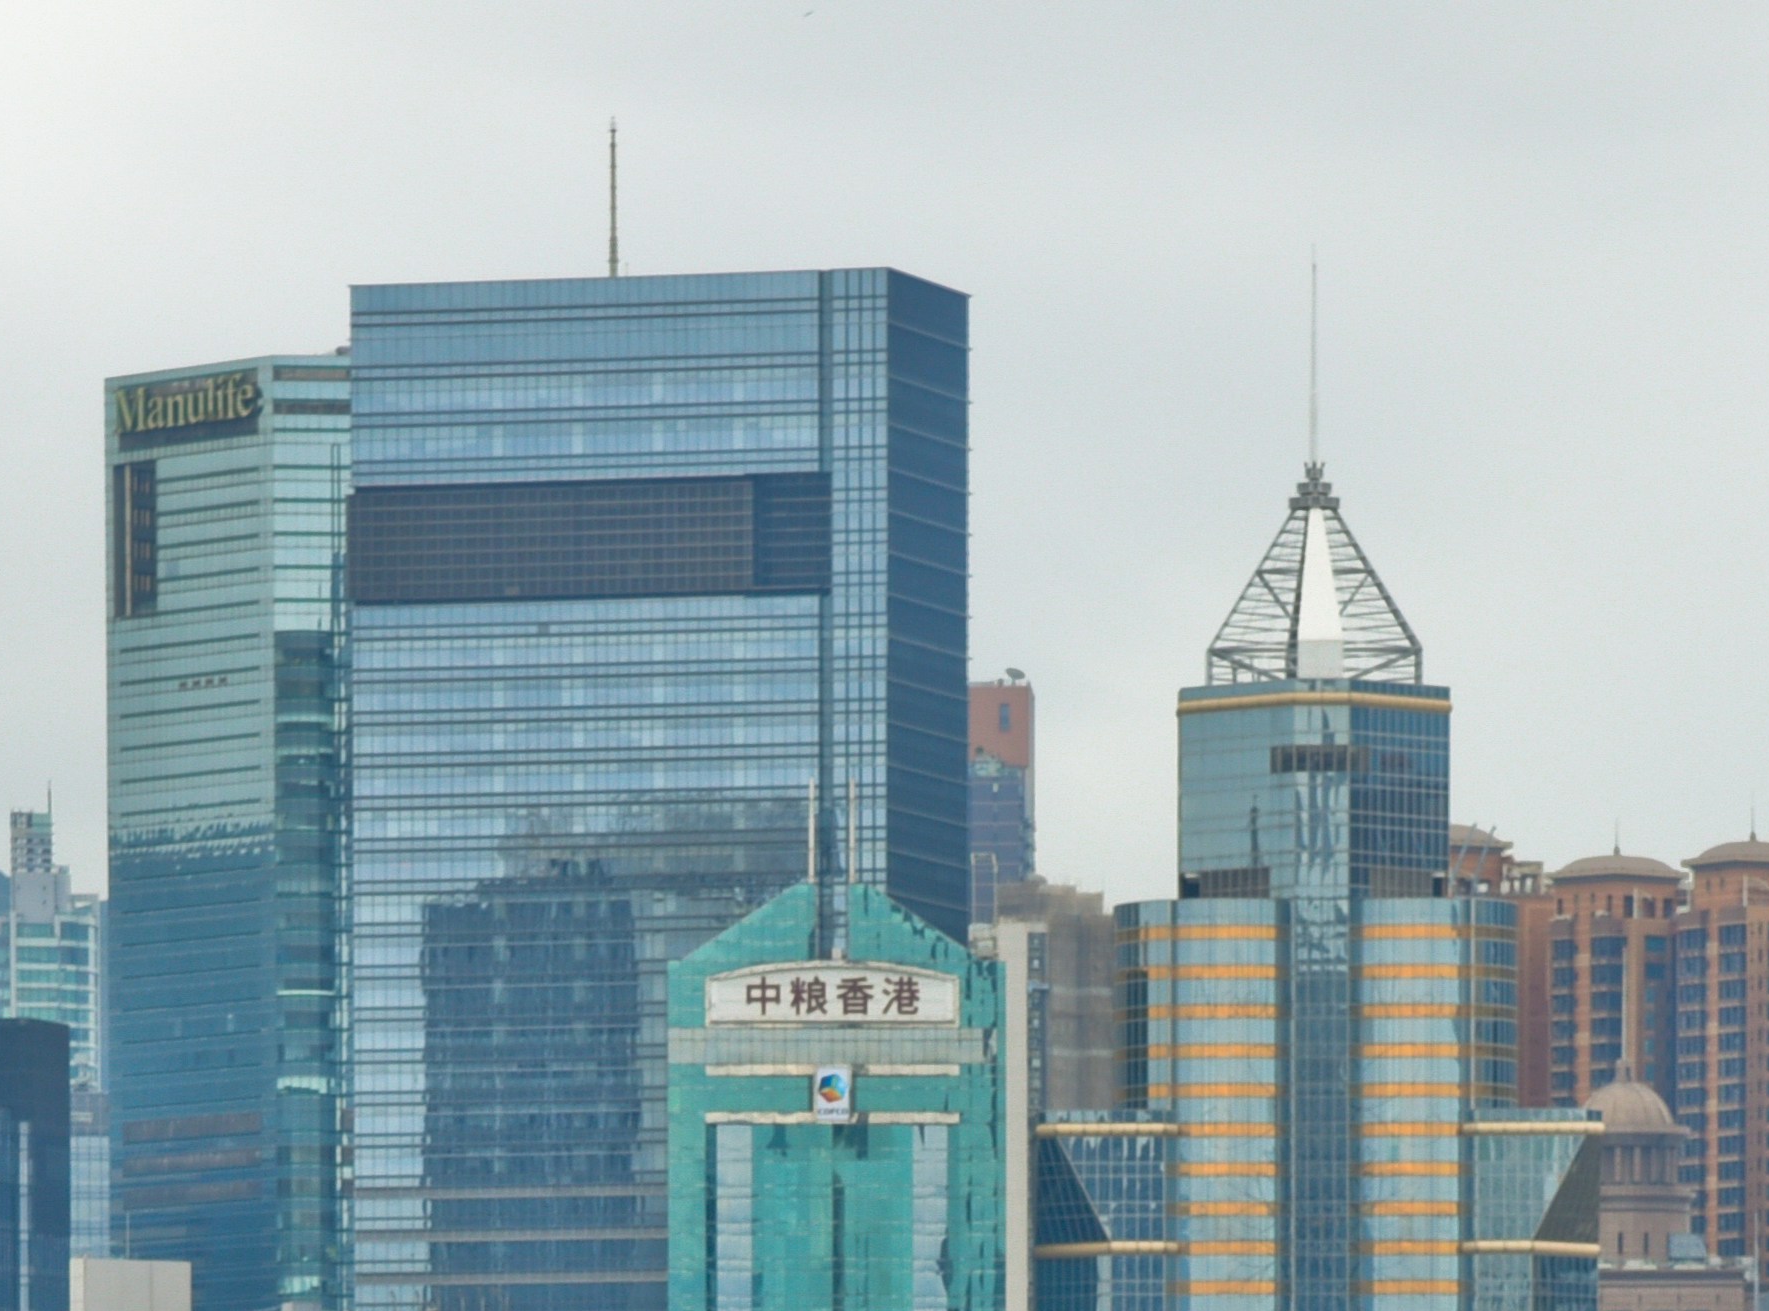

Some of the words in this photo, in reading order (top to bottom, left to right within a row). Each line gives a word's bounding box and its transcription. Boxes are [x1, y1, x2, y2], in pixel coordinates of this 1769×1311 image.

[115, 372, 256, 434] Manulife
[745, 975, 921, 1017] 中粮香港
